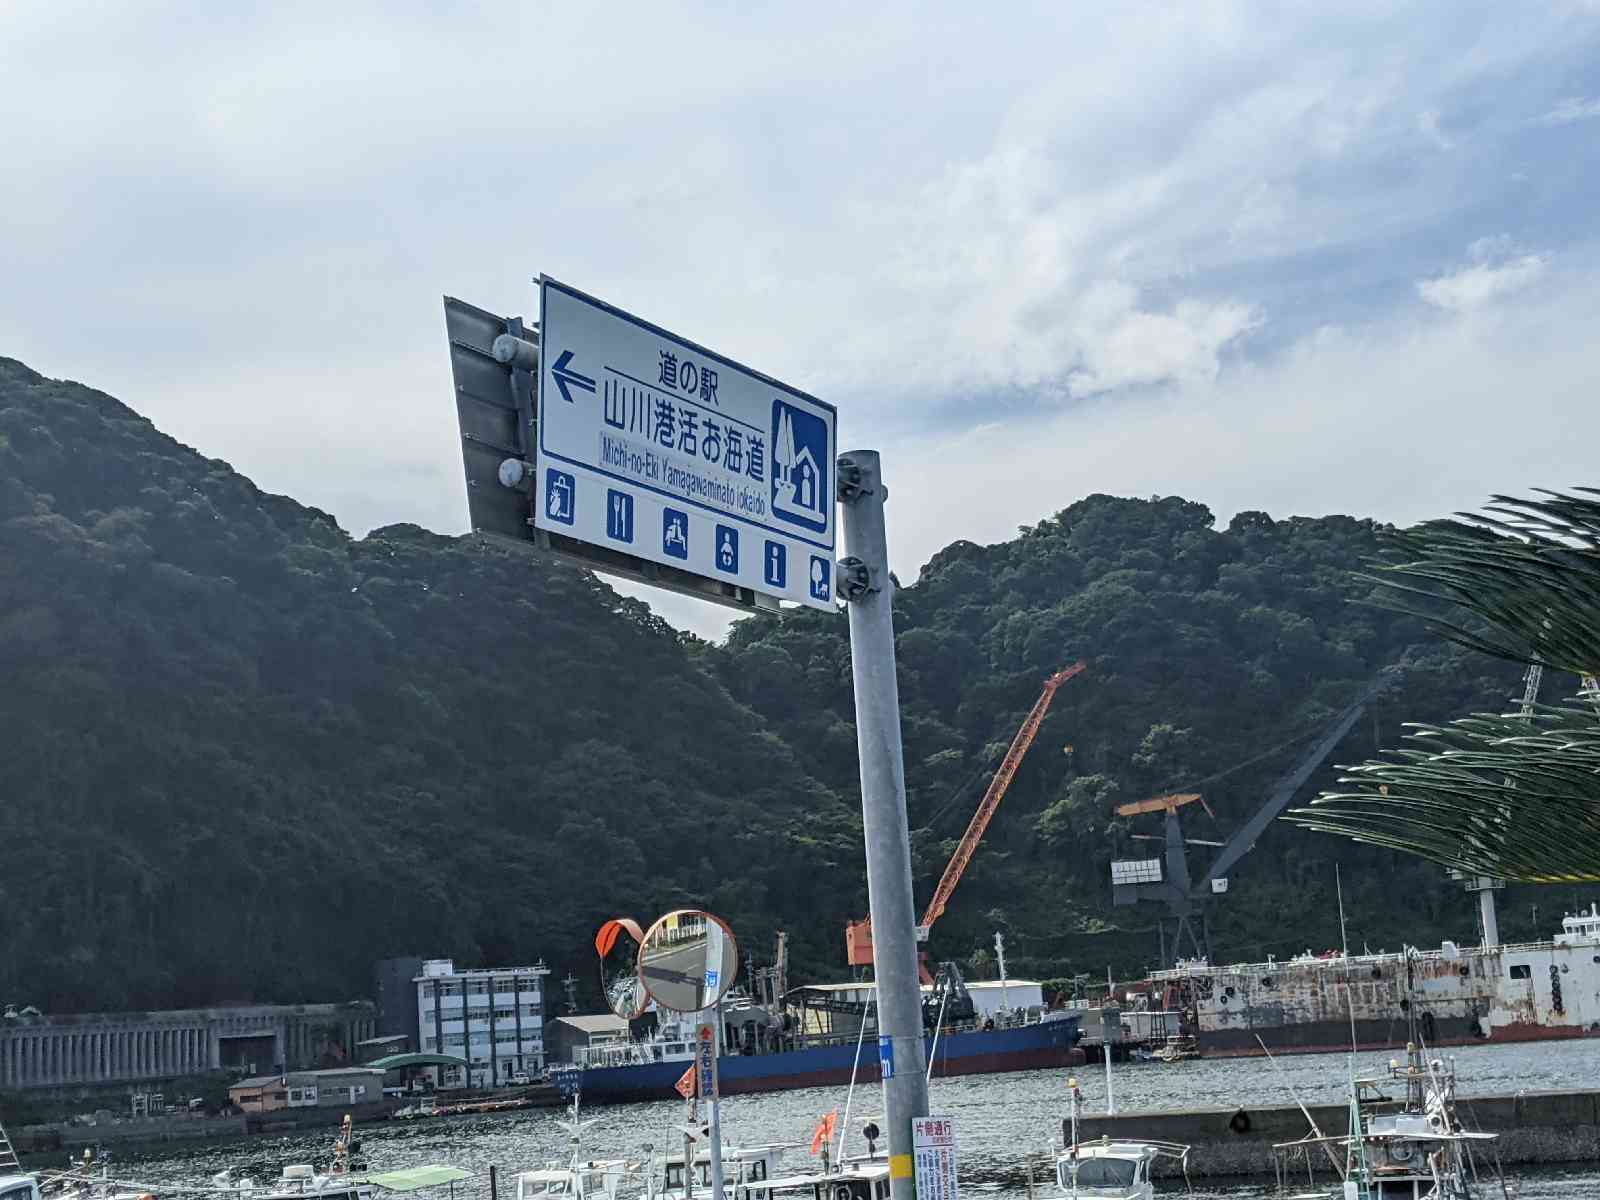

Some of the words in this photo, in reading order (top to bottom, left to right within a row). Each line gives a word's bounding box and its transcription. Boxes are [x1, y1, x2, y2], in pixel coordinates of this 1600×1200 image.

[658, 350, 719, 406] 道の駅
[602, 436, 660, 481] Michi-no-Eki
[604, 379, 765, 483] 山川港活お海道
